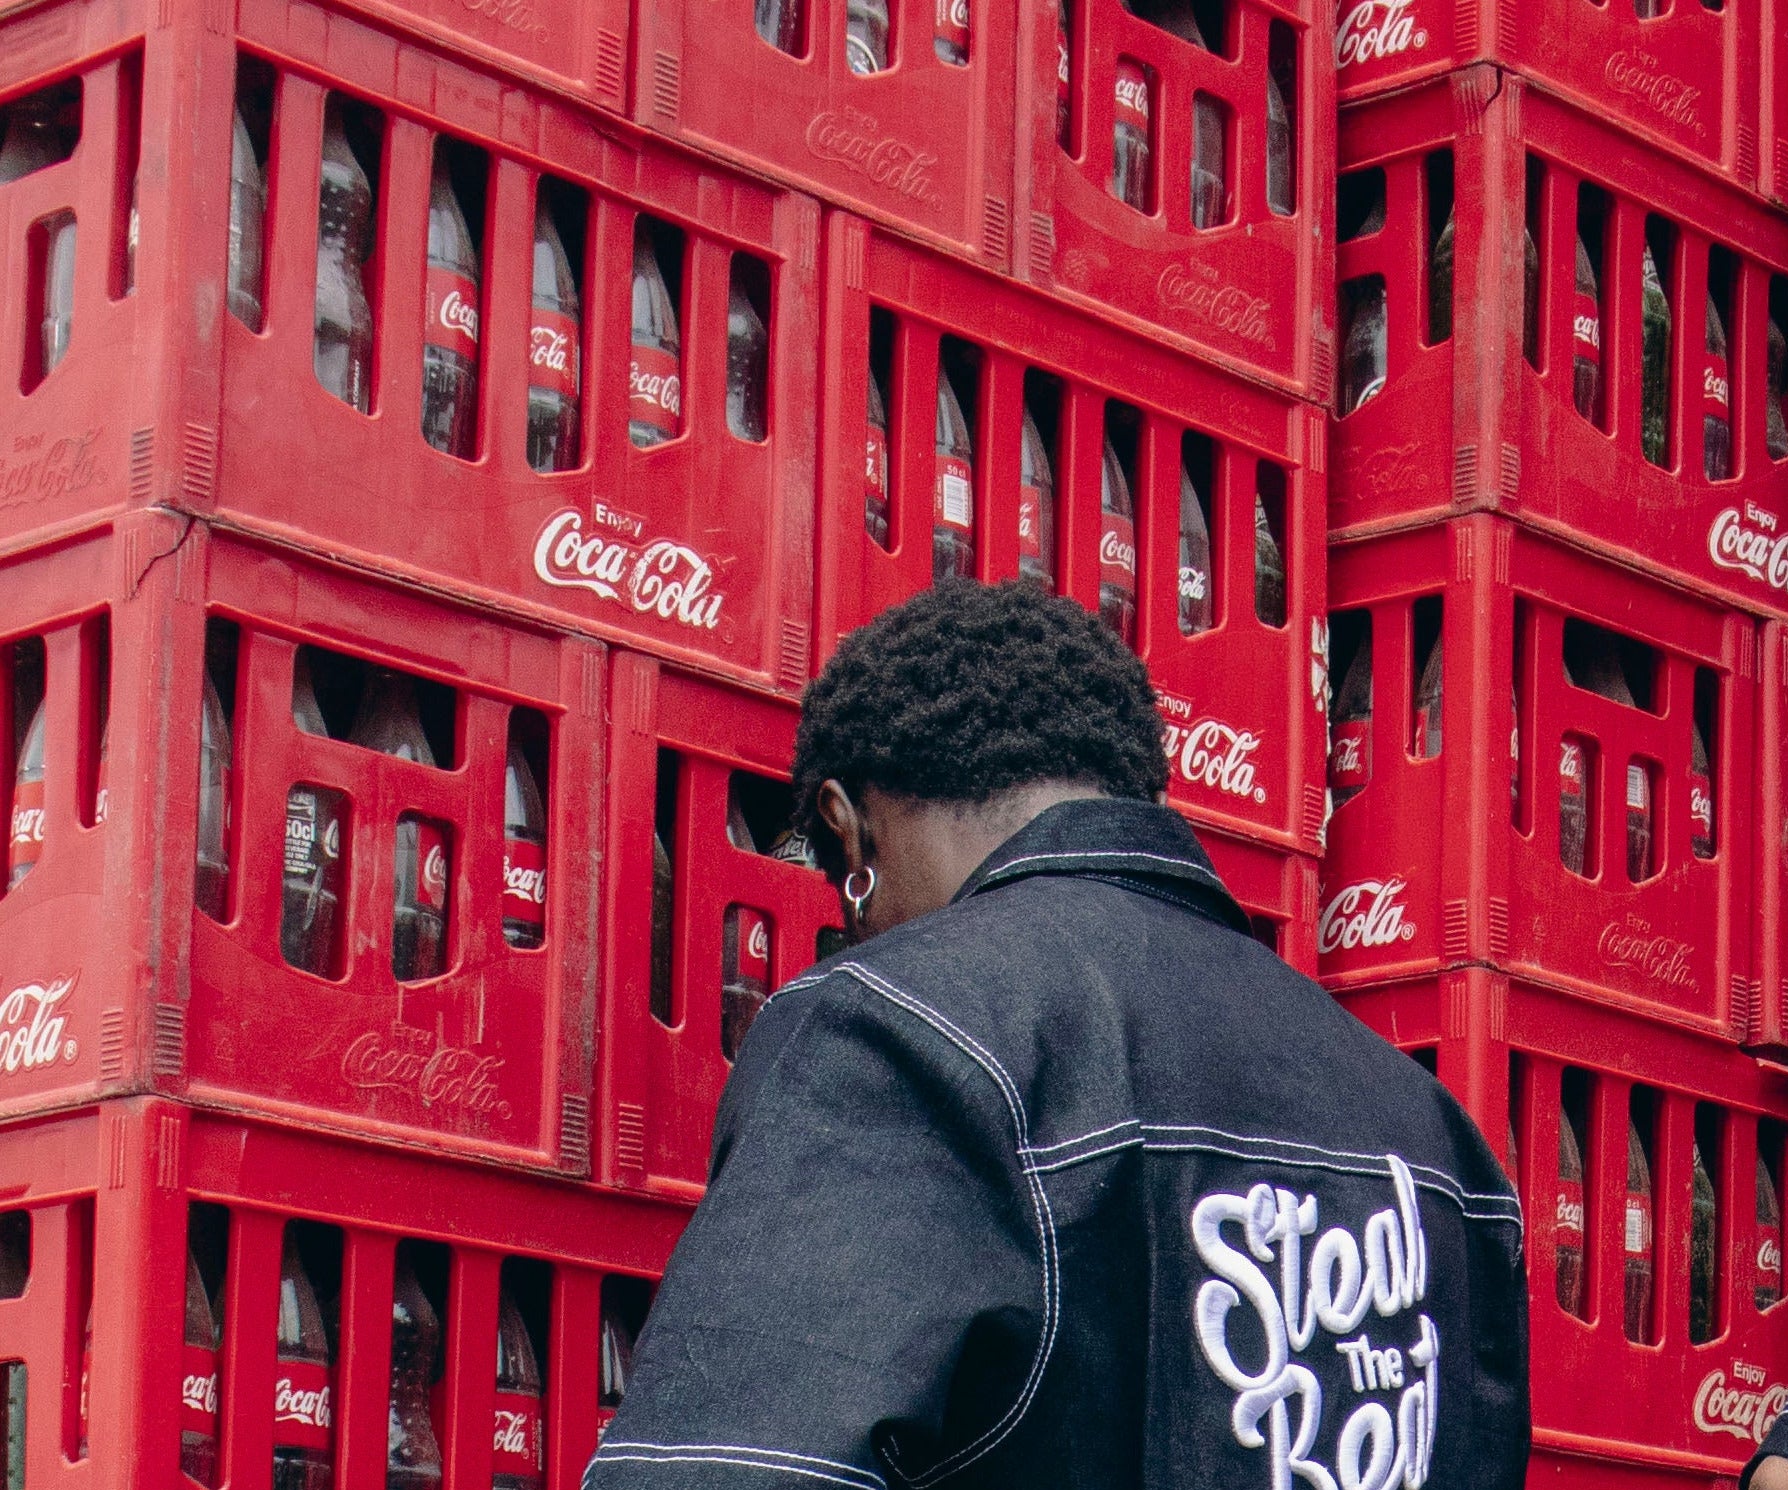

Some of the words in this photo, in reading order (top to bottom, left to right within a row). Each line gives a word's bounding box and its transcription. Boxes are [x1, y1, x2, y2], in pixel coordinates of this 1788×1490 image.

[596, 505, 643, 536] Enjoy
[1747, 502, 1777, 532] Enjoy
[534, 513, 721, 628] Coca-Cola
[1193, 1154, 1427, 1391] Steal
[1337, 1335, 1404, 1391] The
[1734, 1363, 1765, 1385] Enjoy
